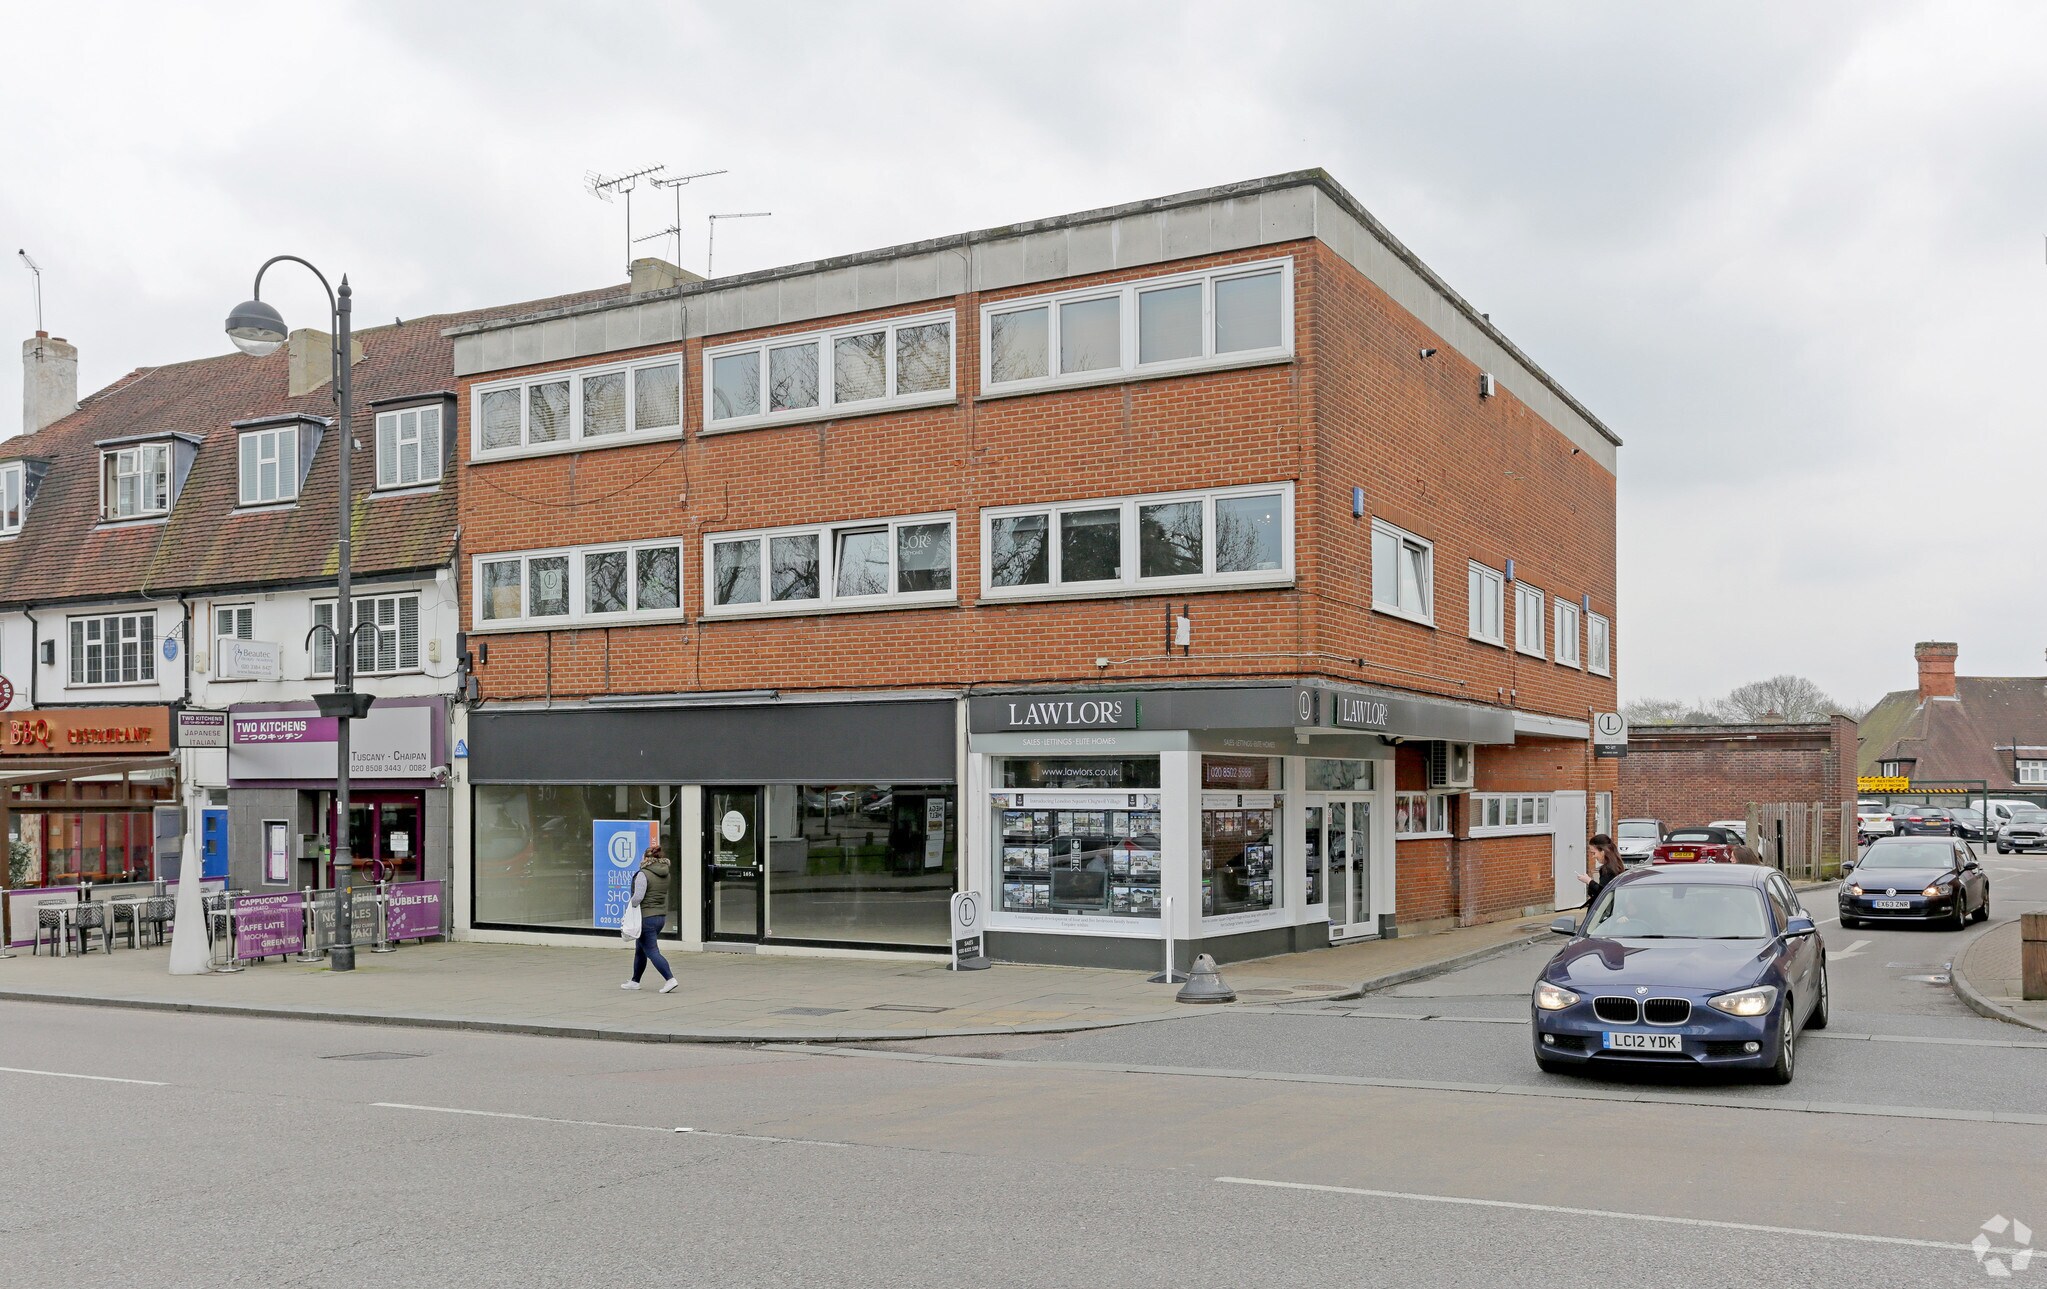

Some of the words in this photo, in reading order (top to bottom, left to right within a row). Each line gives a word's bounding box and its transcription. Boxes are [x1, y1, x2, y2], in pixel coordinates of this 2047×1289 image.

[244, 649, 271, 658] Beautec
[237, 722, 257, 733] TWO
[260, 720, 307, 732] KITCHENS
[10, 720, 48, 748] BBQ
[68, 728, 151, 744] RESTAURANT
[1042, 768, 1118, 776] www.lawlors.co.uk
[1211, 767, 1222, 777] 020
[1223, 767, 1237, 776] 8502
[240, 896, 288, 906] CAPPUCCINO
[390, 896, 422, 906] BUBBLE
[423, 894, 439, 903] TEA
[608, 890, 631, 902] SHO
[605, 904, 619, 916] TO
[239, 924, 262, 932] CAFFE
[261, 939, 285, 947] GREEN
[1615, 1034, 1645, 1047] LC12
[1649, 1036, 1676, 1048] YDK
